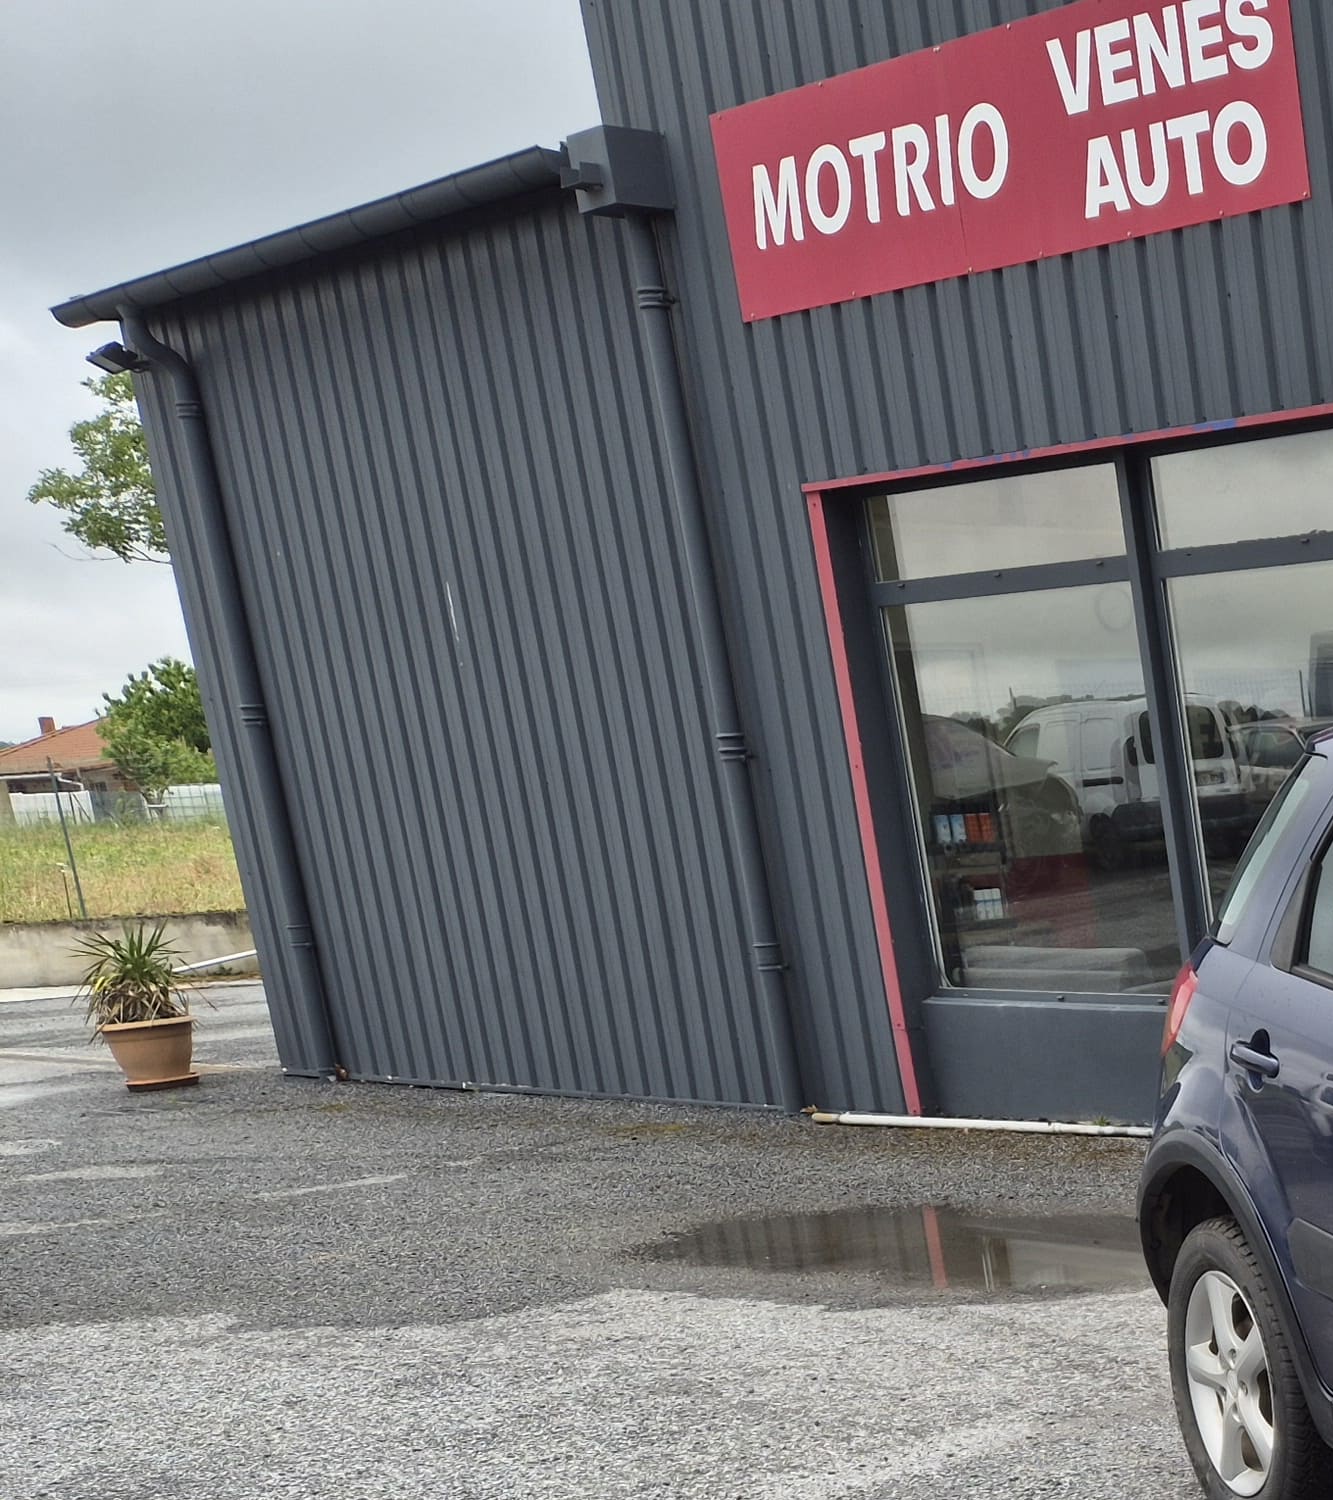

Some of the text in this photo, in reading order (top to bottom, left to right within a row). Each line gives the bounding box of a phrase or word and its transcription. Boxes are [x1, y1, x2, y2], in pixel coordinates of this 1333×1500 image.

[1045, 0, 1273, 116] VENES
[752, 102, 1009, 249] MOTRIO
[1084, 100, 1267, 218] AUTO
